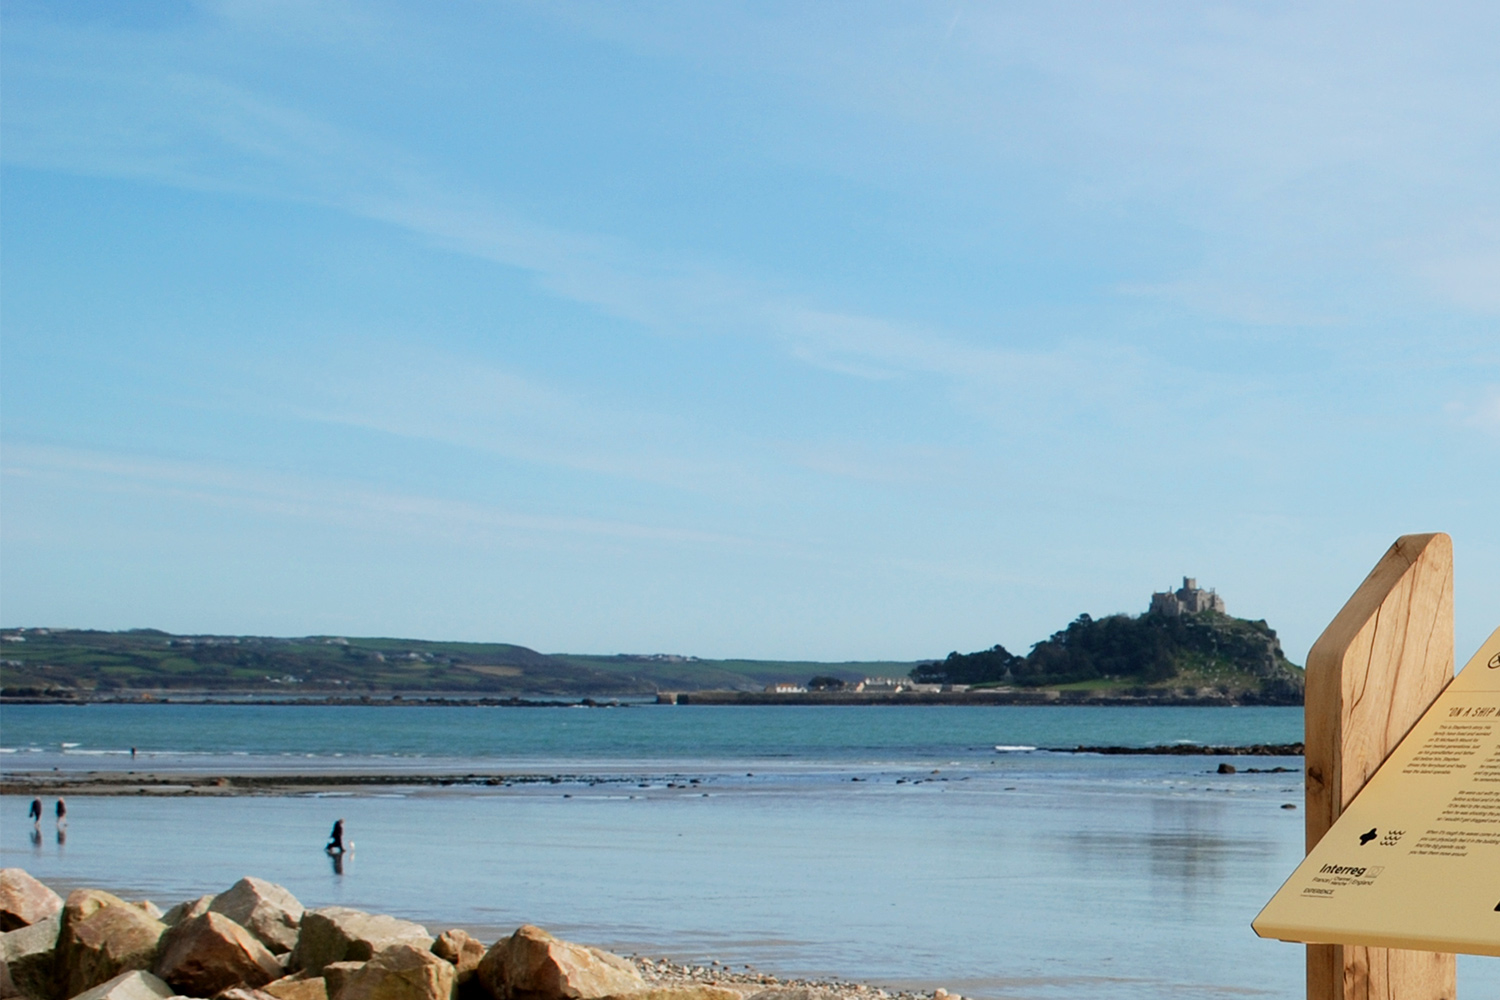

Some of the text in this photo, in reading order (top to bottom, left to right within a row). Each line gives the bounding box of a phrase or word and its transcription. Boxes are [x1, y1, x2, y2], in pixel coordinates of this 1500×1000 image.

[1462, 707, 1472, 717] A
[1472, 707, 1496, 717] SHIP
[1319, 864, 1367, 877] Interreg
